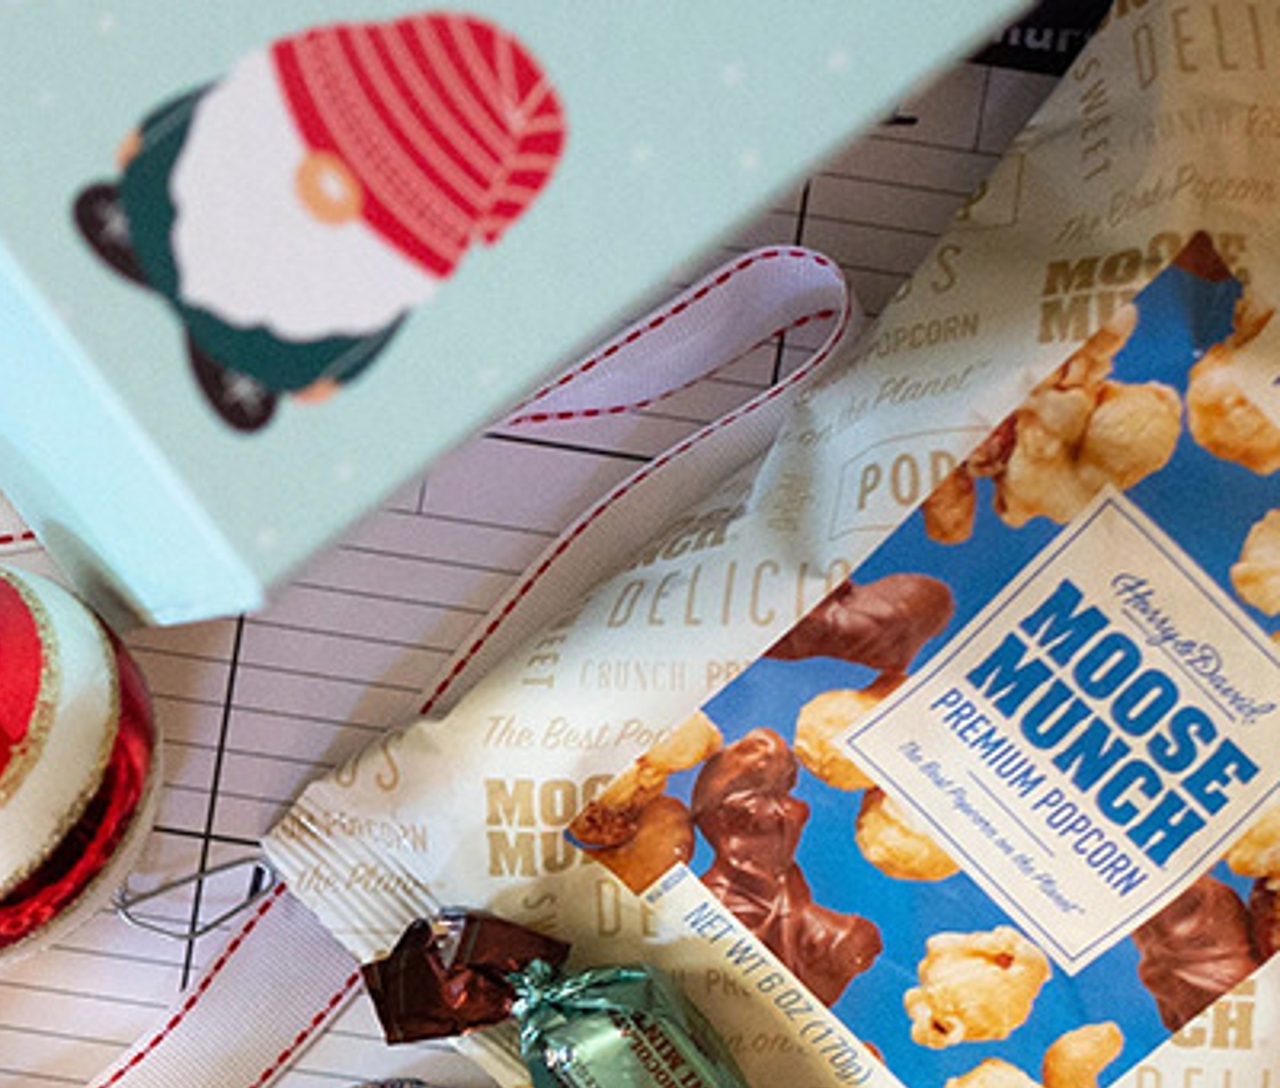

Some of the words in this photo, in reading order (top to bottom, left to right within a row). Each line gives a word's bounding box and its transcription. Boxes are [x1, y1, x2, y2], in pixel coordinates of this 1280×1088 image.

[1132, 3, 1280, 91] DELI
[481, 714, 535, 747] The
[541, 715, 608, 749] Best
[578, 659, 686, 692] CRUNCH
[965, 631, 1207, 868] MUNCH
[1018, 577, 1260, 816] MOOSE
[930, 687, 1046, 798] PREMIUM
[1031, 787, 1149, 897] POPCORN
[683, 900, 735, 944] NET
[725, 937, 768, 977] WT
[756, 972, 785, 994] 6
[774, 988, 815, 1022] OZ
[799, 1018, 875, 1086] (170g)
